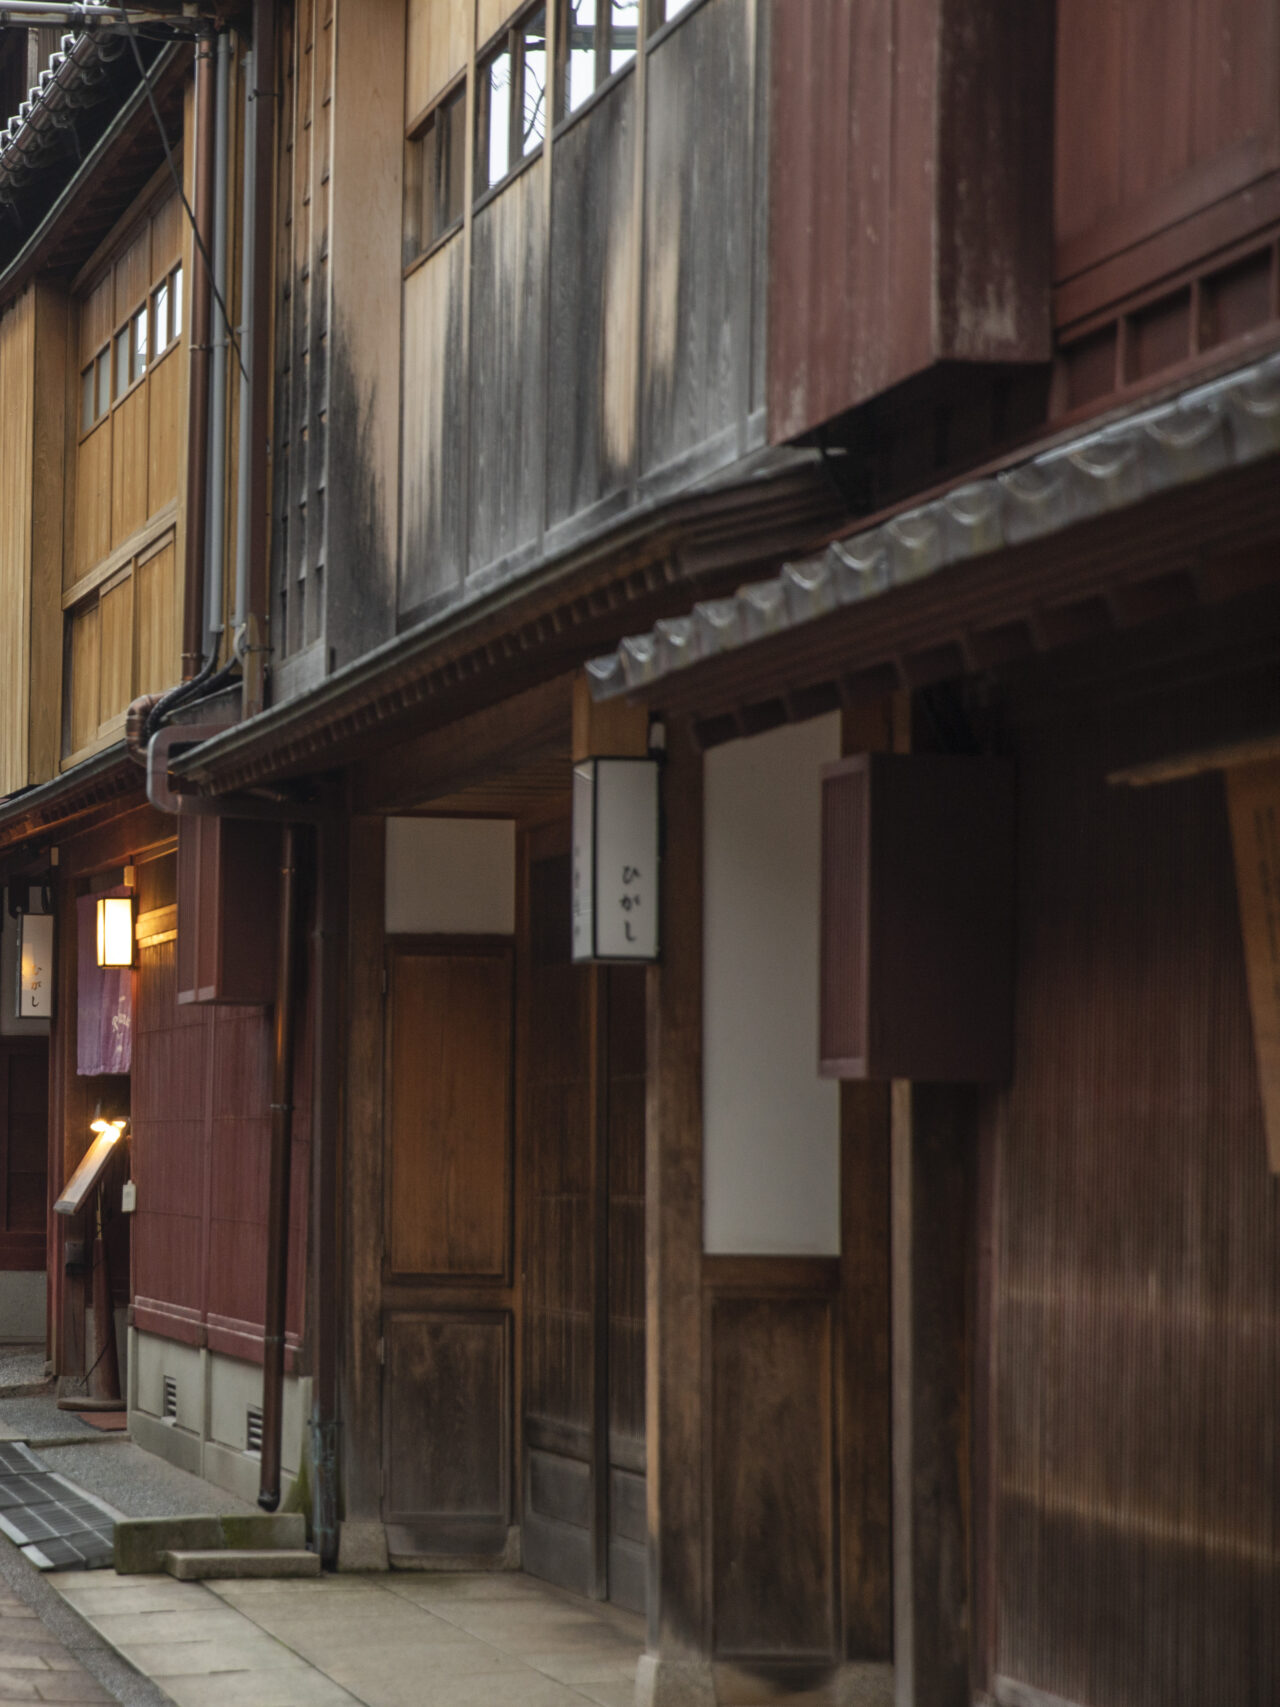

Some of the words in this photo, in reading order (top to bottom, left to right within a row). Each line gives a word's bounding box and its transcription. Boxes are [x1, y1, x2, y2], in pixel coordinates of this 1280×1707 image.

[620, 865, 641, 942] ひがし
[31, 964, 42, 1007] ひがし
